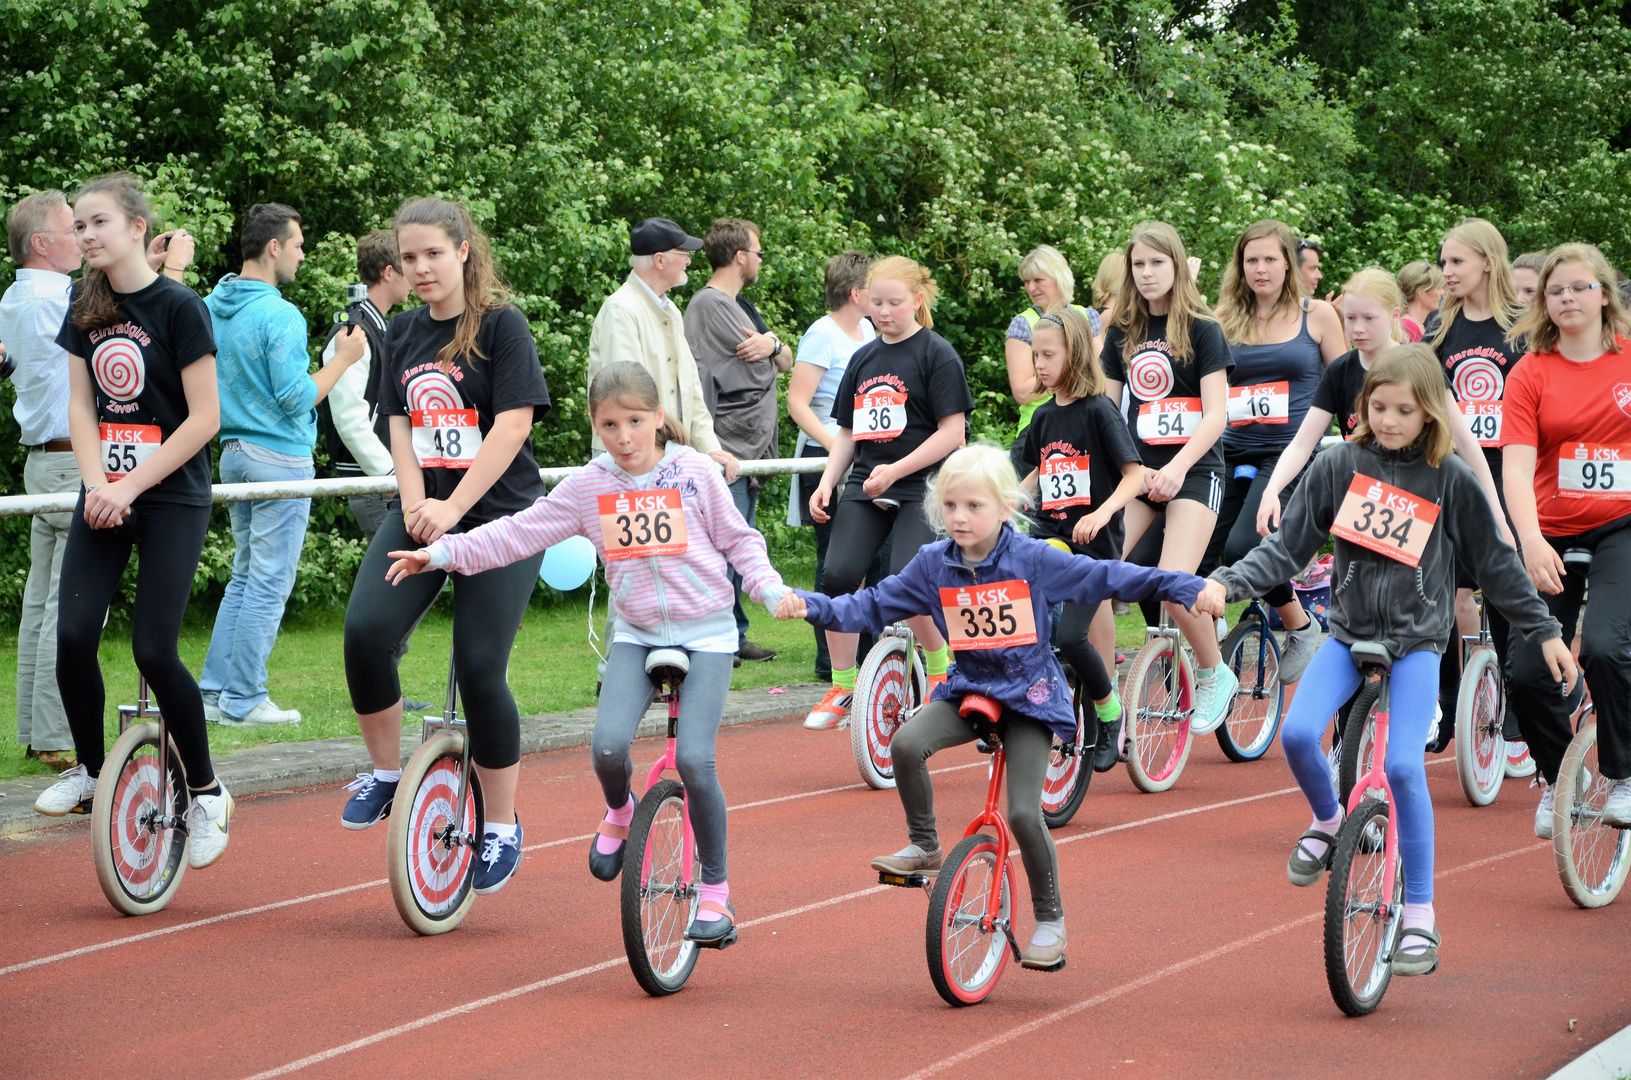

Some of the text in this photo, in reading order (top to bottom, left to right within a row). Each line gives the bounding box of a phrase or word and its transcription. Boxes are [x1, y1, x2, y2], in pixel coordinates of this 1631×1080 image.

[89, 321, 151, 347] Einradgirls
[106, 399, 139, 414] Zeven
[875, 395, 895, 406] KSK
[1165, 402, 1188, 412] KSK
[1246, 396, 1271, 417] 16
[1479, 404, 1503, 415] KSK
[438, 414, 468, 427] KSK
[868, 406, 892, 431] 36
[1157, 413, 1184, 437] 54
[1470, 415, 1497, 439] 49
[115, 430, 143, 443] KSK
[433, 428, 462, 458] 48
[107, 444, 137, 472] 55
[1055, 460, 1080, 473] KSK
[1593, 448, 1620, 461] KSK
[1050, 473, 1077, 499] 33
[1581, 462, 1615, 490] 95
[635, 495, 667, 511] KSK
[1385, 492, 1420, 517] KSK
[616, 511, 672, 547] 336
[1353, 501, 1414, 548] 334
[976, 587, 1010, 605] KSK
[960, 603, 1017, 638] 335
